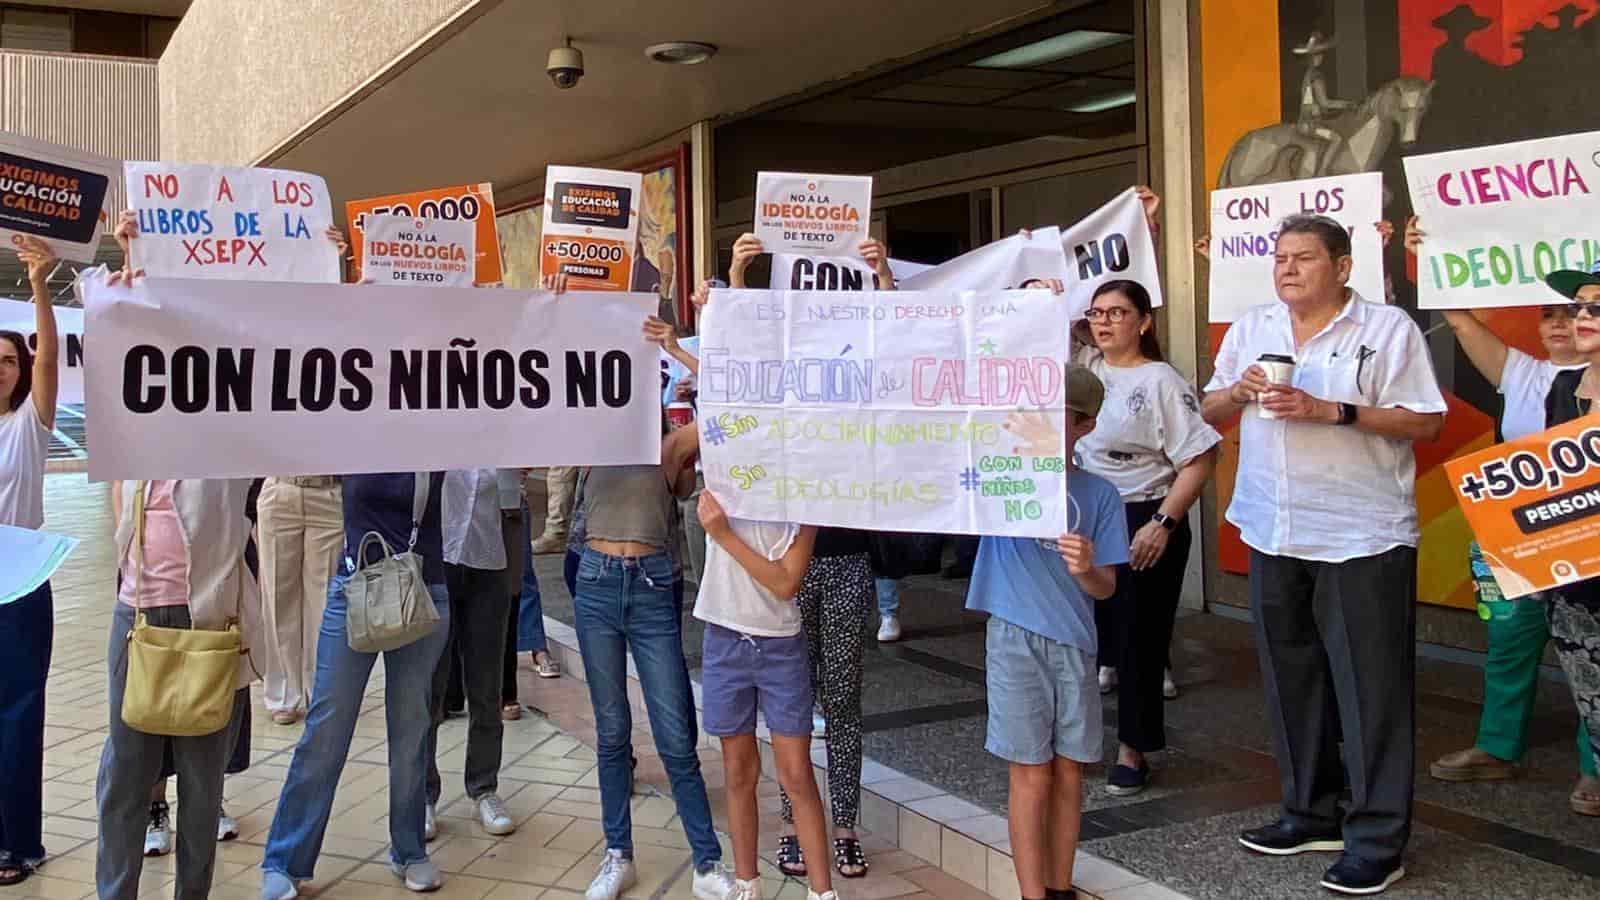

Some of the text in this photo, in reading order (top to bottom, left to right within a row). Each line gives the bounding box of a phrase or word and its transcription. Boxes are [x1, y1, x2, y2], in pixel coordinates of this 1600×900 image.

[145, 173, 314, 207] NO A LOS
[790, 194, 830, 204] NO A LA
[3, 194, 80, 220] CALIDAD
[561, 195, 620, 209] EDUCACIÓN
[1301, 188, 1345, 214] LOS
[762, 203, 859, 221] IDEOLOGÍA
[138, 208, 312, 239] LIBROS DE LA
[398, 231, 437, 242] NO A LA
[784, 231, 834, 242] DE TEXTO
[183, 239, 267, 266] XSEPX
[370, 241, 466, 262] IDEOLOGÍA
[547, 243, 622, 260] +50,000
[1074, 233, 1130, 280] NO
[393, 271, 443, 282] DE TEXTO
[563, 265, 605, 276] PERSONAS
[757, 302, 1017, 321] ES NUESTRO DERECHO UNA
[122, 344, 255, 414] CON
[271, 347, 374, 413] LOS
[389, 337, 551, 410] NIÑOS
[565, 349, 632, 408] NO
[702, 343, 873, 403] EDUCACIÓN
[912, 356, 1062, 407] CALIDAD
[1032, 457, 1064, 473] LOS
[1005, 500, 1042, 521] NO
